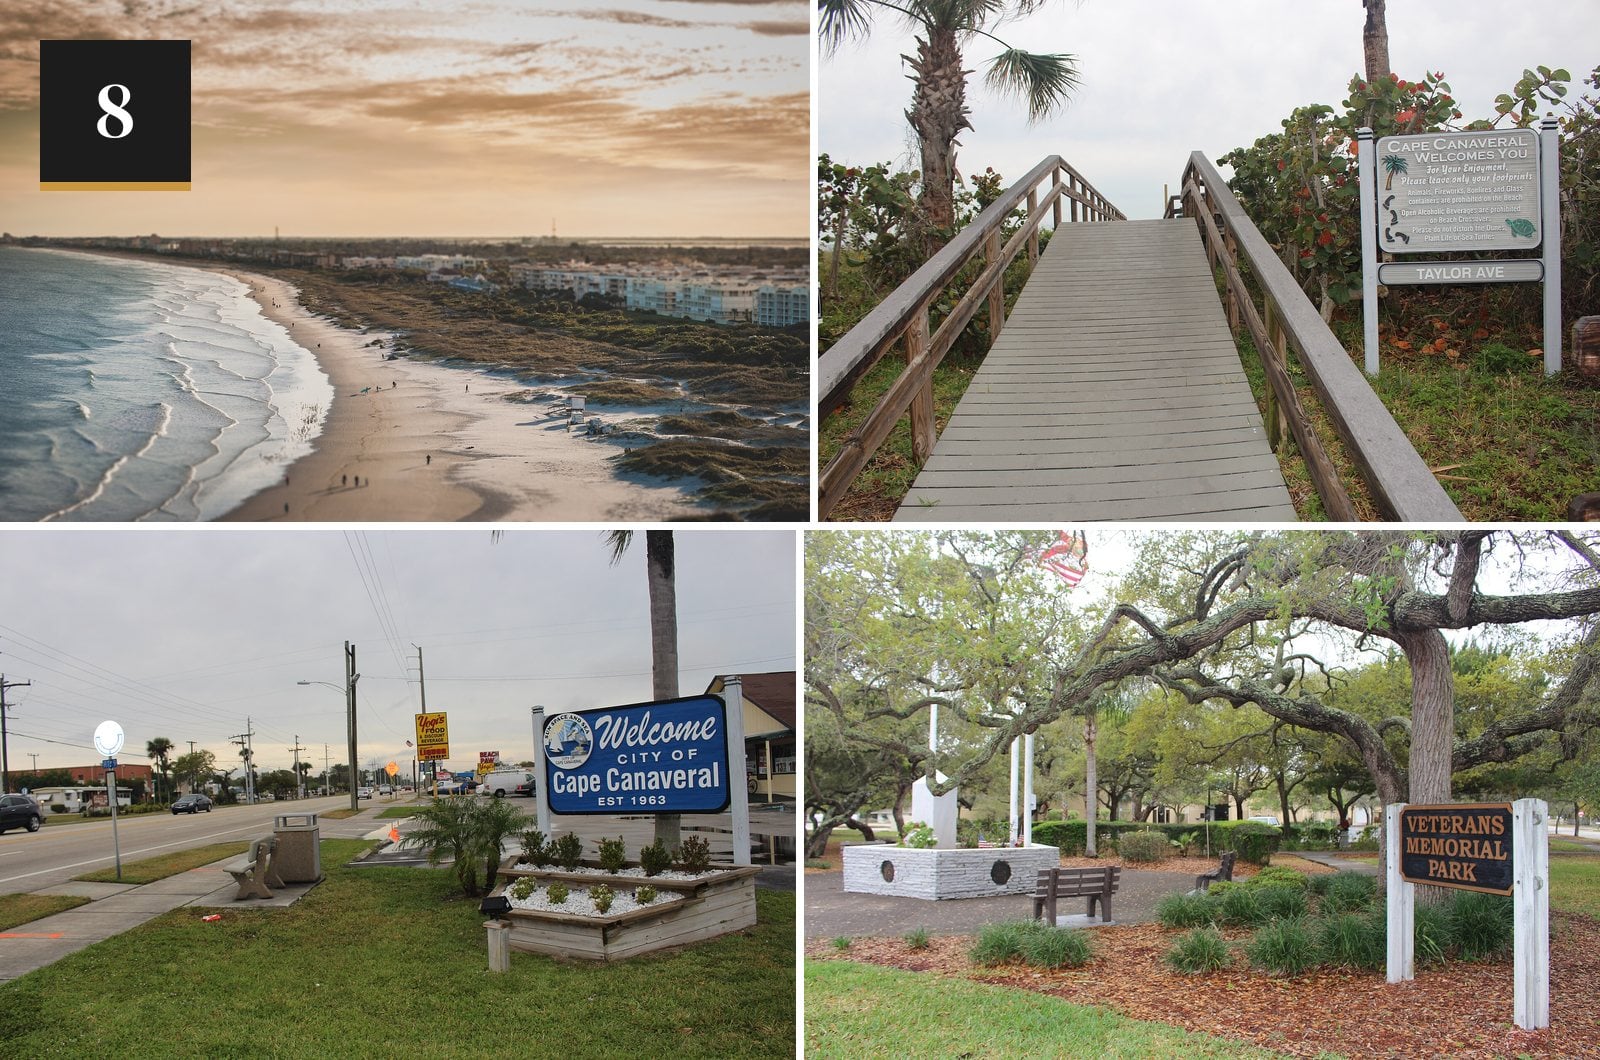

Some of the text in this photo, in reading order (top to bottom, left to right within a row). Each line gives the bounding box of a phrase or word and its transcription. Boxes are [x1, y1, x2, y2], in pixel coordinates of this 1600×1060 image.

[1387, 137, 1528, 153] CAPE CANAVERAL
[1414, 149, 1528, 163] WELCOMES YOU
[1426, 166, 1440, 174] For
[1441, 165, 1461, 174] Your
[1401, 171, 1532, 185] Please leave only your footprints
[1401, 209, 1417, 217] Open
[1446, 207, 1477, 215] Beverages
[1416, 266, 1505, 280] TAYLOR AVE
[594, 711, 717, 750] Welcome
[617, 749, 698, 765] CITY OF
[553, 762, 720, 798] Cape Canaveral
[598, 795, 666, 806] EST 1963
[1406, 815, 1505, 836] VETERANS
[1406, 837, 1508, 861] MEMORIAL
[1428, 859, 1477, 882] PARK
